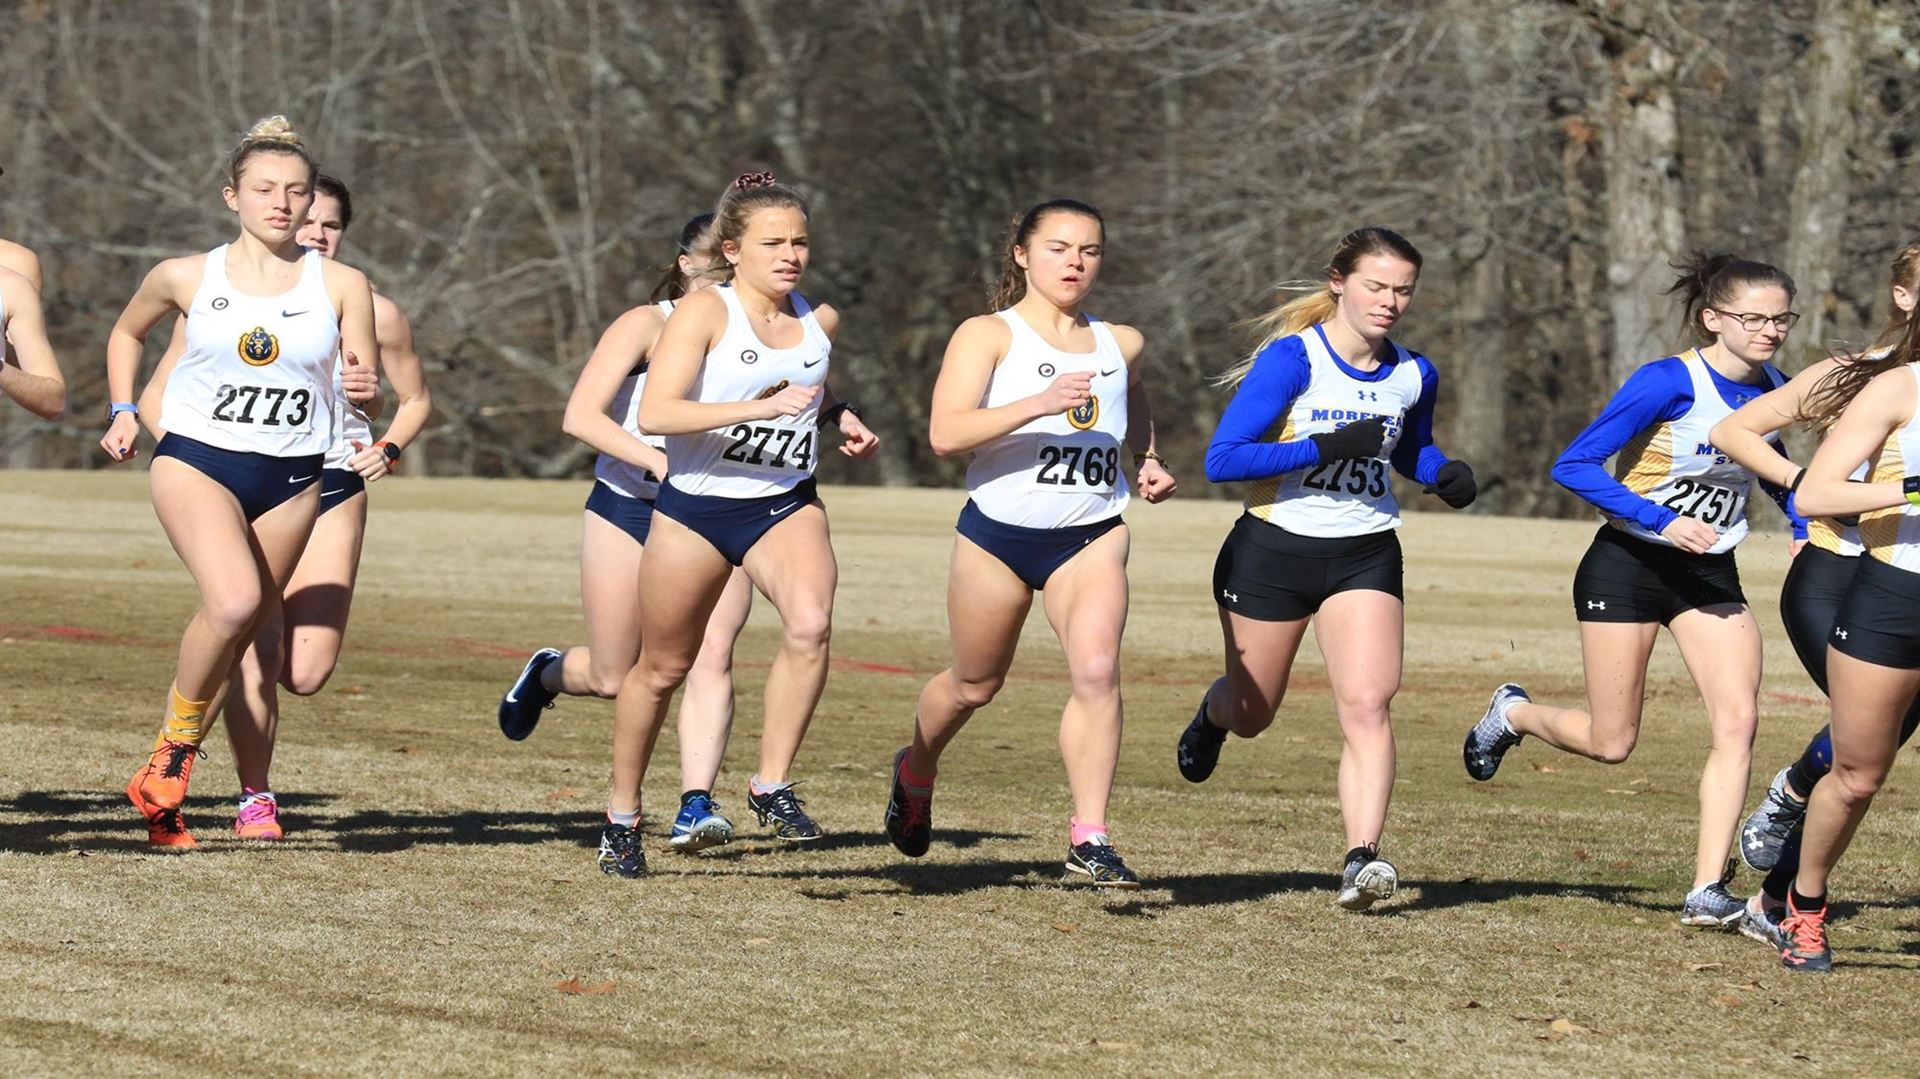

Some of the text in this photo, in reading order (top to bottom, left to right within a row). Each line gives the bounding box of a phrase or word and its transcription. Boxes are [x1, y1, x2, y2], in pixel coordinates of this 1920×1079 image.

[212, 384, 310, 426] 2773
[722, 424, 813, 470] 2774
[1036, 445, 1118, 487] 2768
[1303, 458, 1386, 498] 2753
[1662, 479, 1739, 527] 2751
